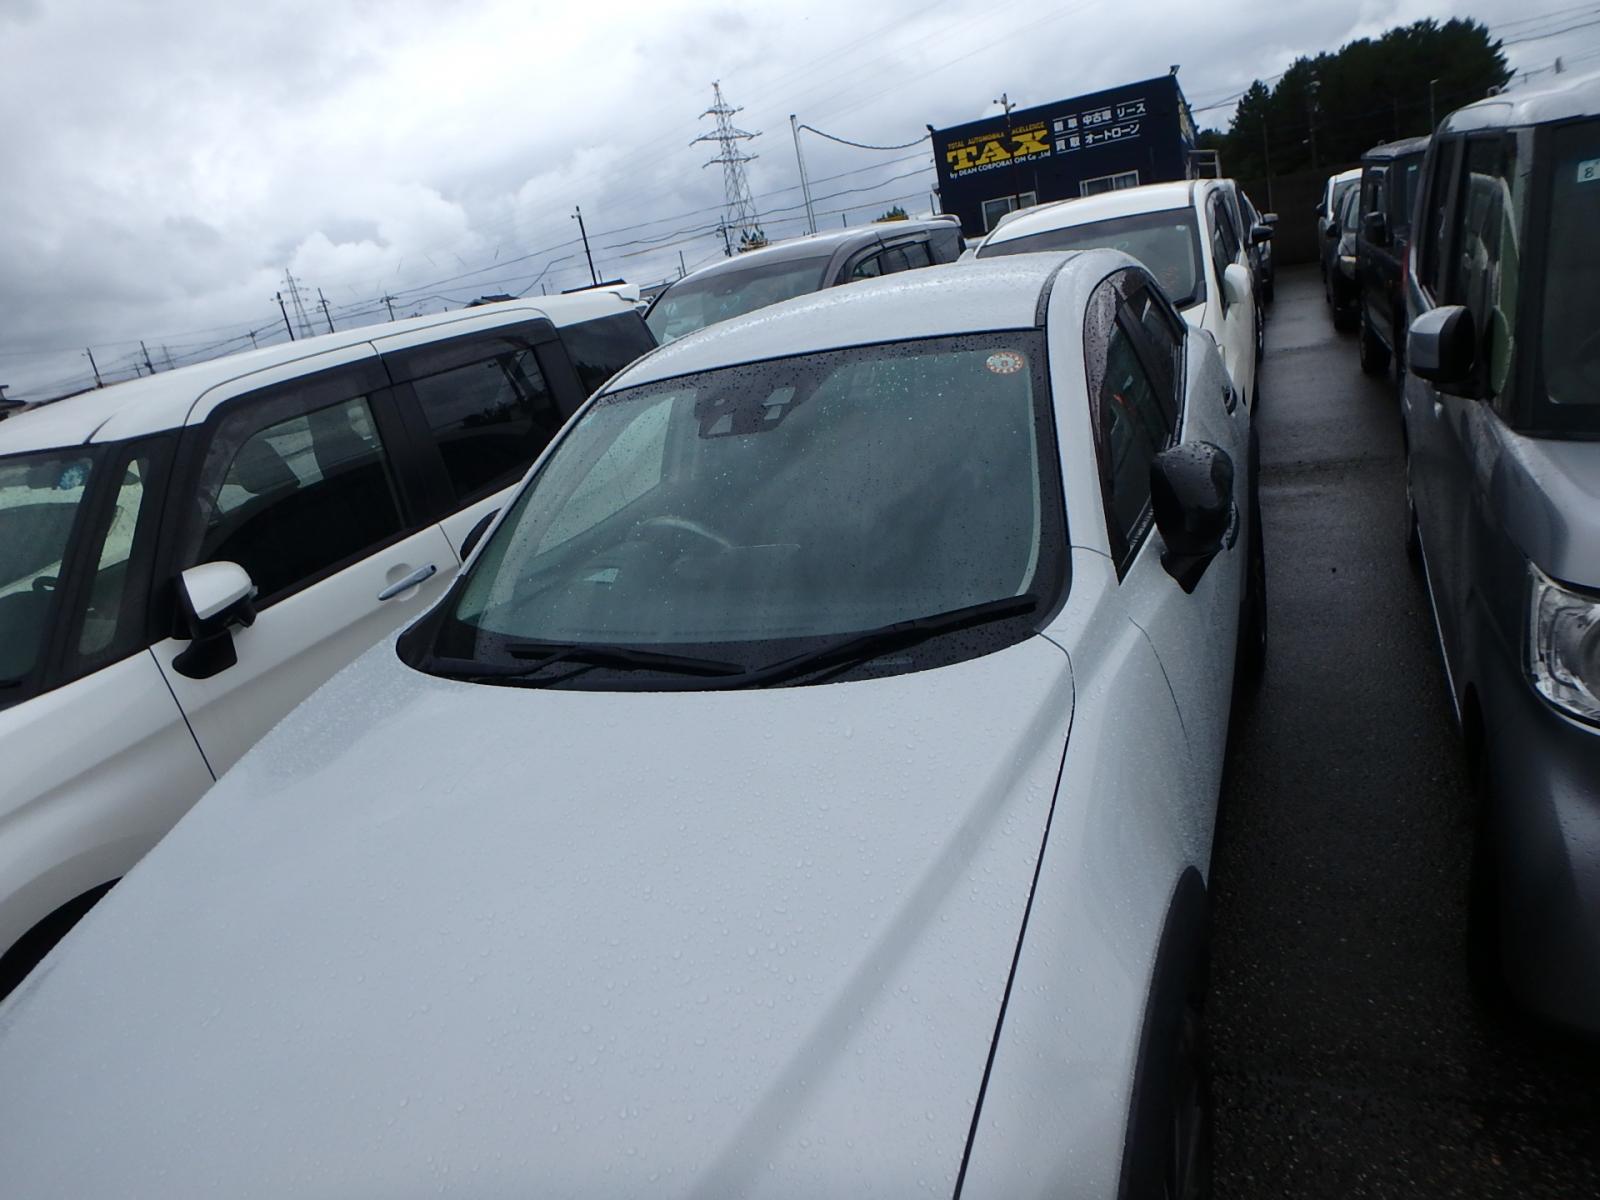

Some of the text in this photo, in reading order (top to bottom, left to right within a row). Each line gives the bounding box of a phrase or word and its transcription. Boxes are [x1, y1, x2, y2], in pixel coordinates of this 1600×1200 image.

[1082, 109, 1112, 125] 中古車
[1117, 103, 1146, 117] リース
[948, 140, 965, 150] TOTAL
[1055, 123, 1140, 151] 買取 オートローン
[946, 129, 1050, 171] TAX
[950, 171, 959, 180] by
[978, 156, 1026, 173] CORPORATON
